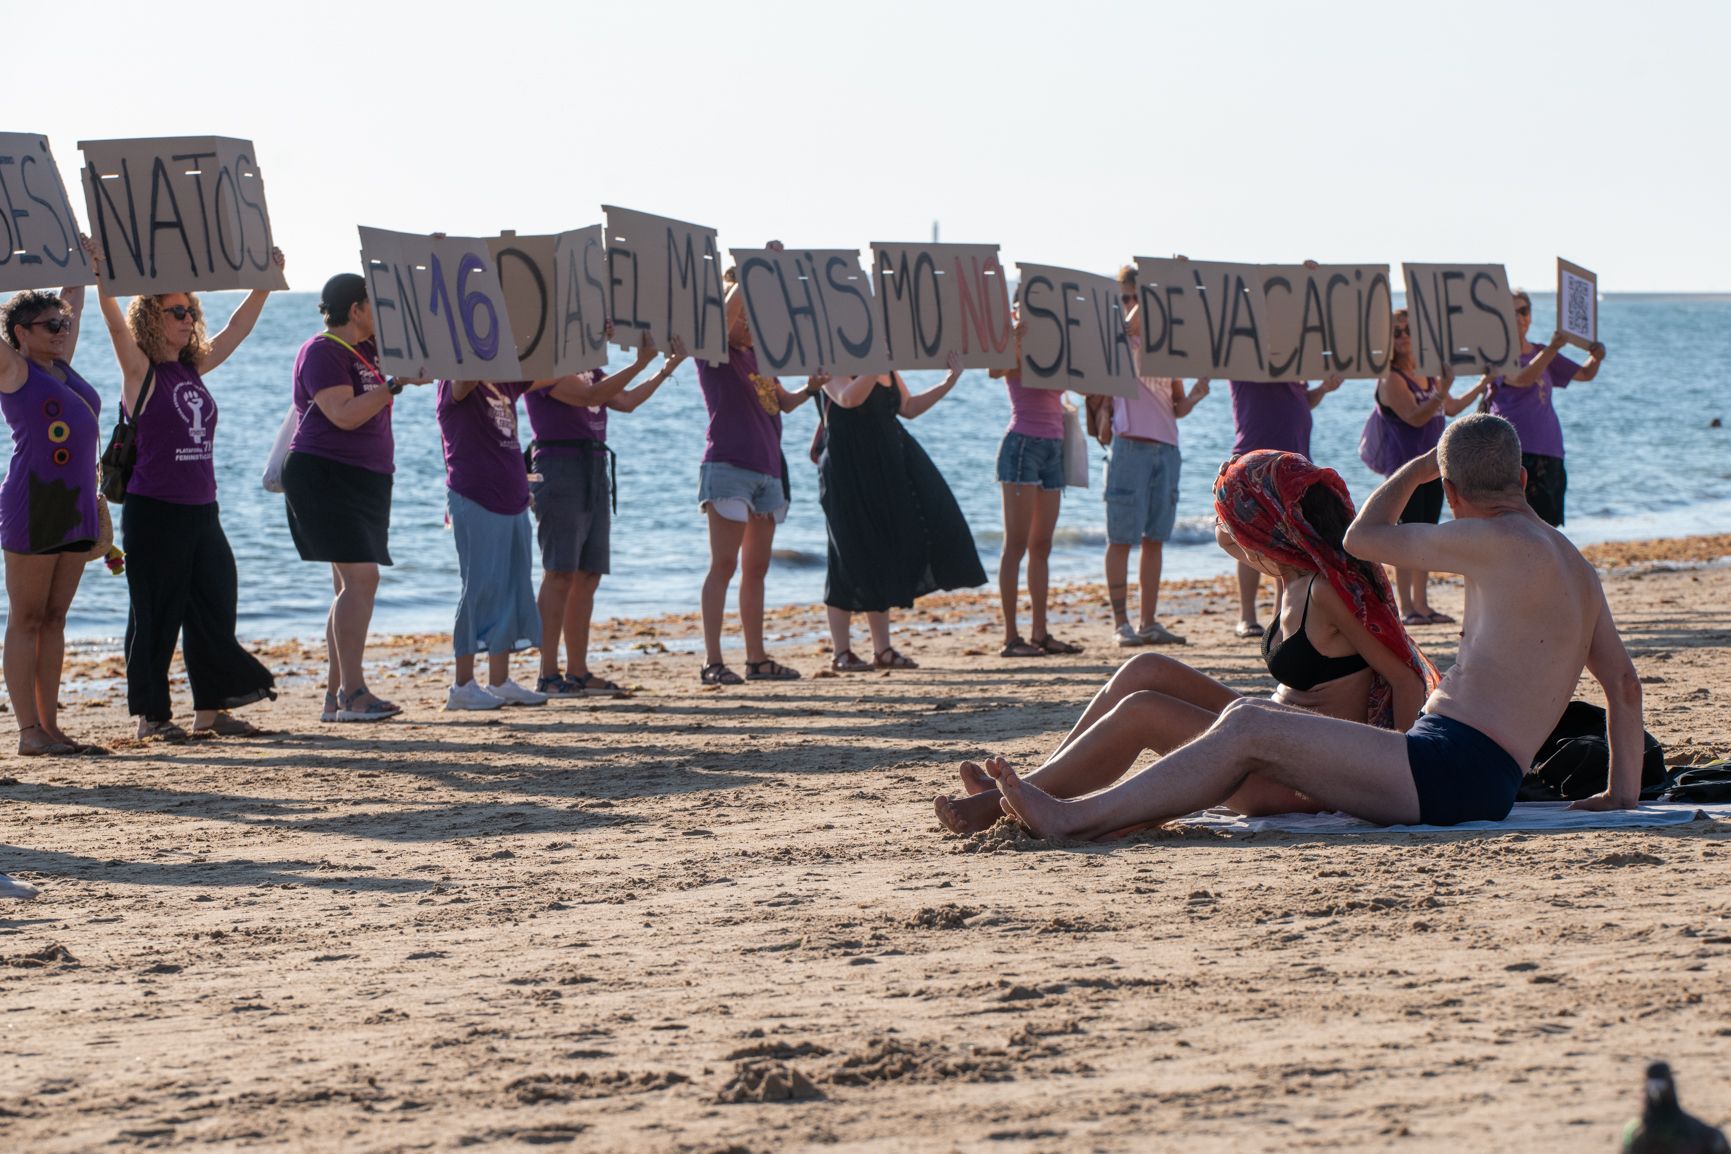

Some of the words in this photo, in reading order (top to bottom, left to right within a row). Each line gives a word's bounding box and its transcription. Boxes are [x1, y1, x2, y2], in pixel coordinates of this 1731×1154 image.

[89, 152, 269, 280] NATOS
[368, 262, 428, 360] EN
[429, 251, 499, 364] 16
[608, 247, 650, 329] EL
[667, 227, 726, 353] MA
[880, 250, 942, 360] MO
[954, 256, 1009, 354] NO
[1024, 275, 1084, 378] SE
[1092, 287, 1136, 379] VA
[1140, 284, 1188, 358] DE
